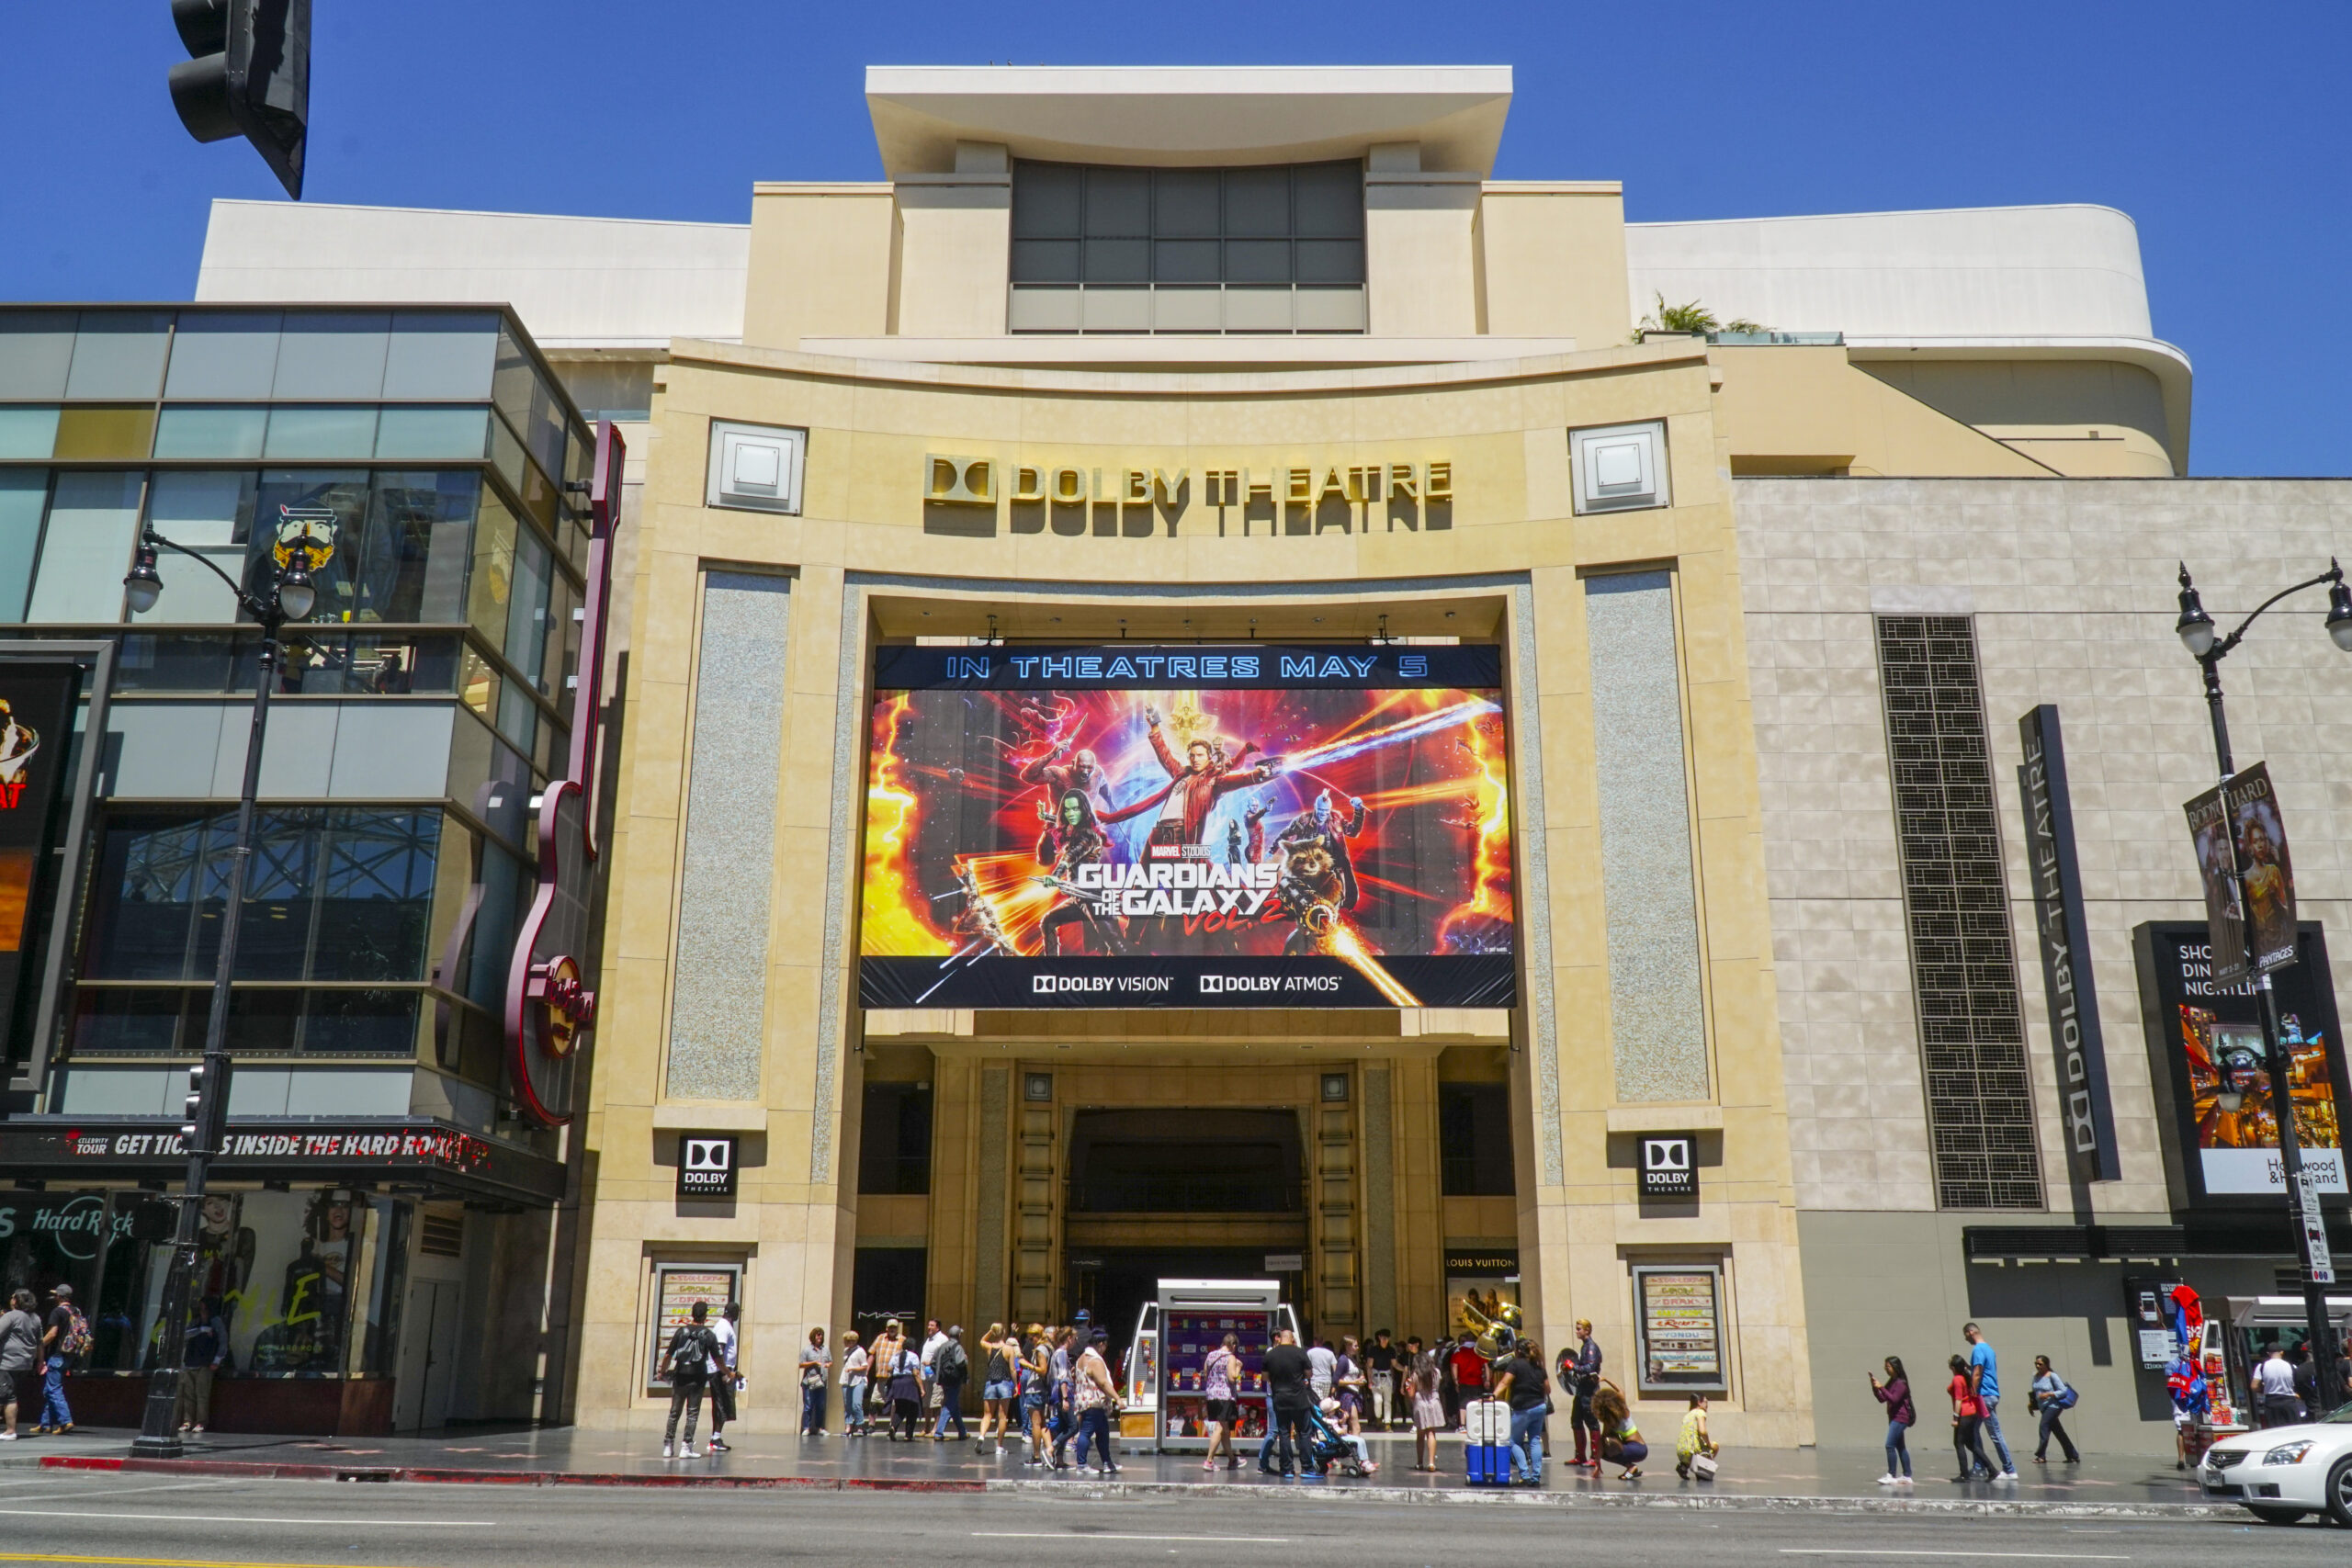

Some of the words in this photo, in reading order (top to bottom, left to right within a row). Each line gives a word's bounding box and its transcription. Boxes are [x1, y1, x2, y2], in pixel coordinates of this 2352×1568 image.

[1011, 462, 1190, 504] DOLBY
[1206, 462, 1453, 504] THEATRE
[947, 656, 989, 679] IN
[1012, 656, 1260, 679] THEATRES
[1281, 656, 1377, 679] MAY
[1399, 655, 1428, 678] 5
[2026, 737, 2062, 929] THEATRE
[1151, 844, 1181, 857] MARVEL
[1182, 844, 1212, 857] STUDIOS
[1078, 863, 1281, 889] GUARDIANS
[1092, 902, 1121, 916] THE
[1122, 889, 1272, 916] GALAXY
[1102, 889, 1120, 902] OF
[1182, 906, 1253, 936] VOL.
[1261, 898, 1287, 923] 2
[1058, 976, 1114, 991] DOLBY
[1226, 976, 1282, 991] DOLBY
[2052, 940, 2084, 1083] DOLBY
[76, 1144, 107, 1155] TOUR
[115, 1134, 154, 1155] GET
[153, 1134, 233, 1155] TICS
[235, 1134, 302, 1156] INSIDE
[304, 1134, 341, 1156] THE
[341, 1134, 401, 1156] HARD
[2267, 1158, 2336, 1171] Howood
[684, 1172, 728, 1184] DOLBY
[1646, 1172, 1690, 1184] DOLBY
[32, 1208, 84, 1232] Hard
[85, 1209, 134, 1236] Rck
[1446, 1258, 1474, 1267] LOUIS
[1475, 1258, 1515, 1267] VUITTON
